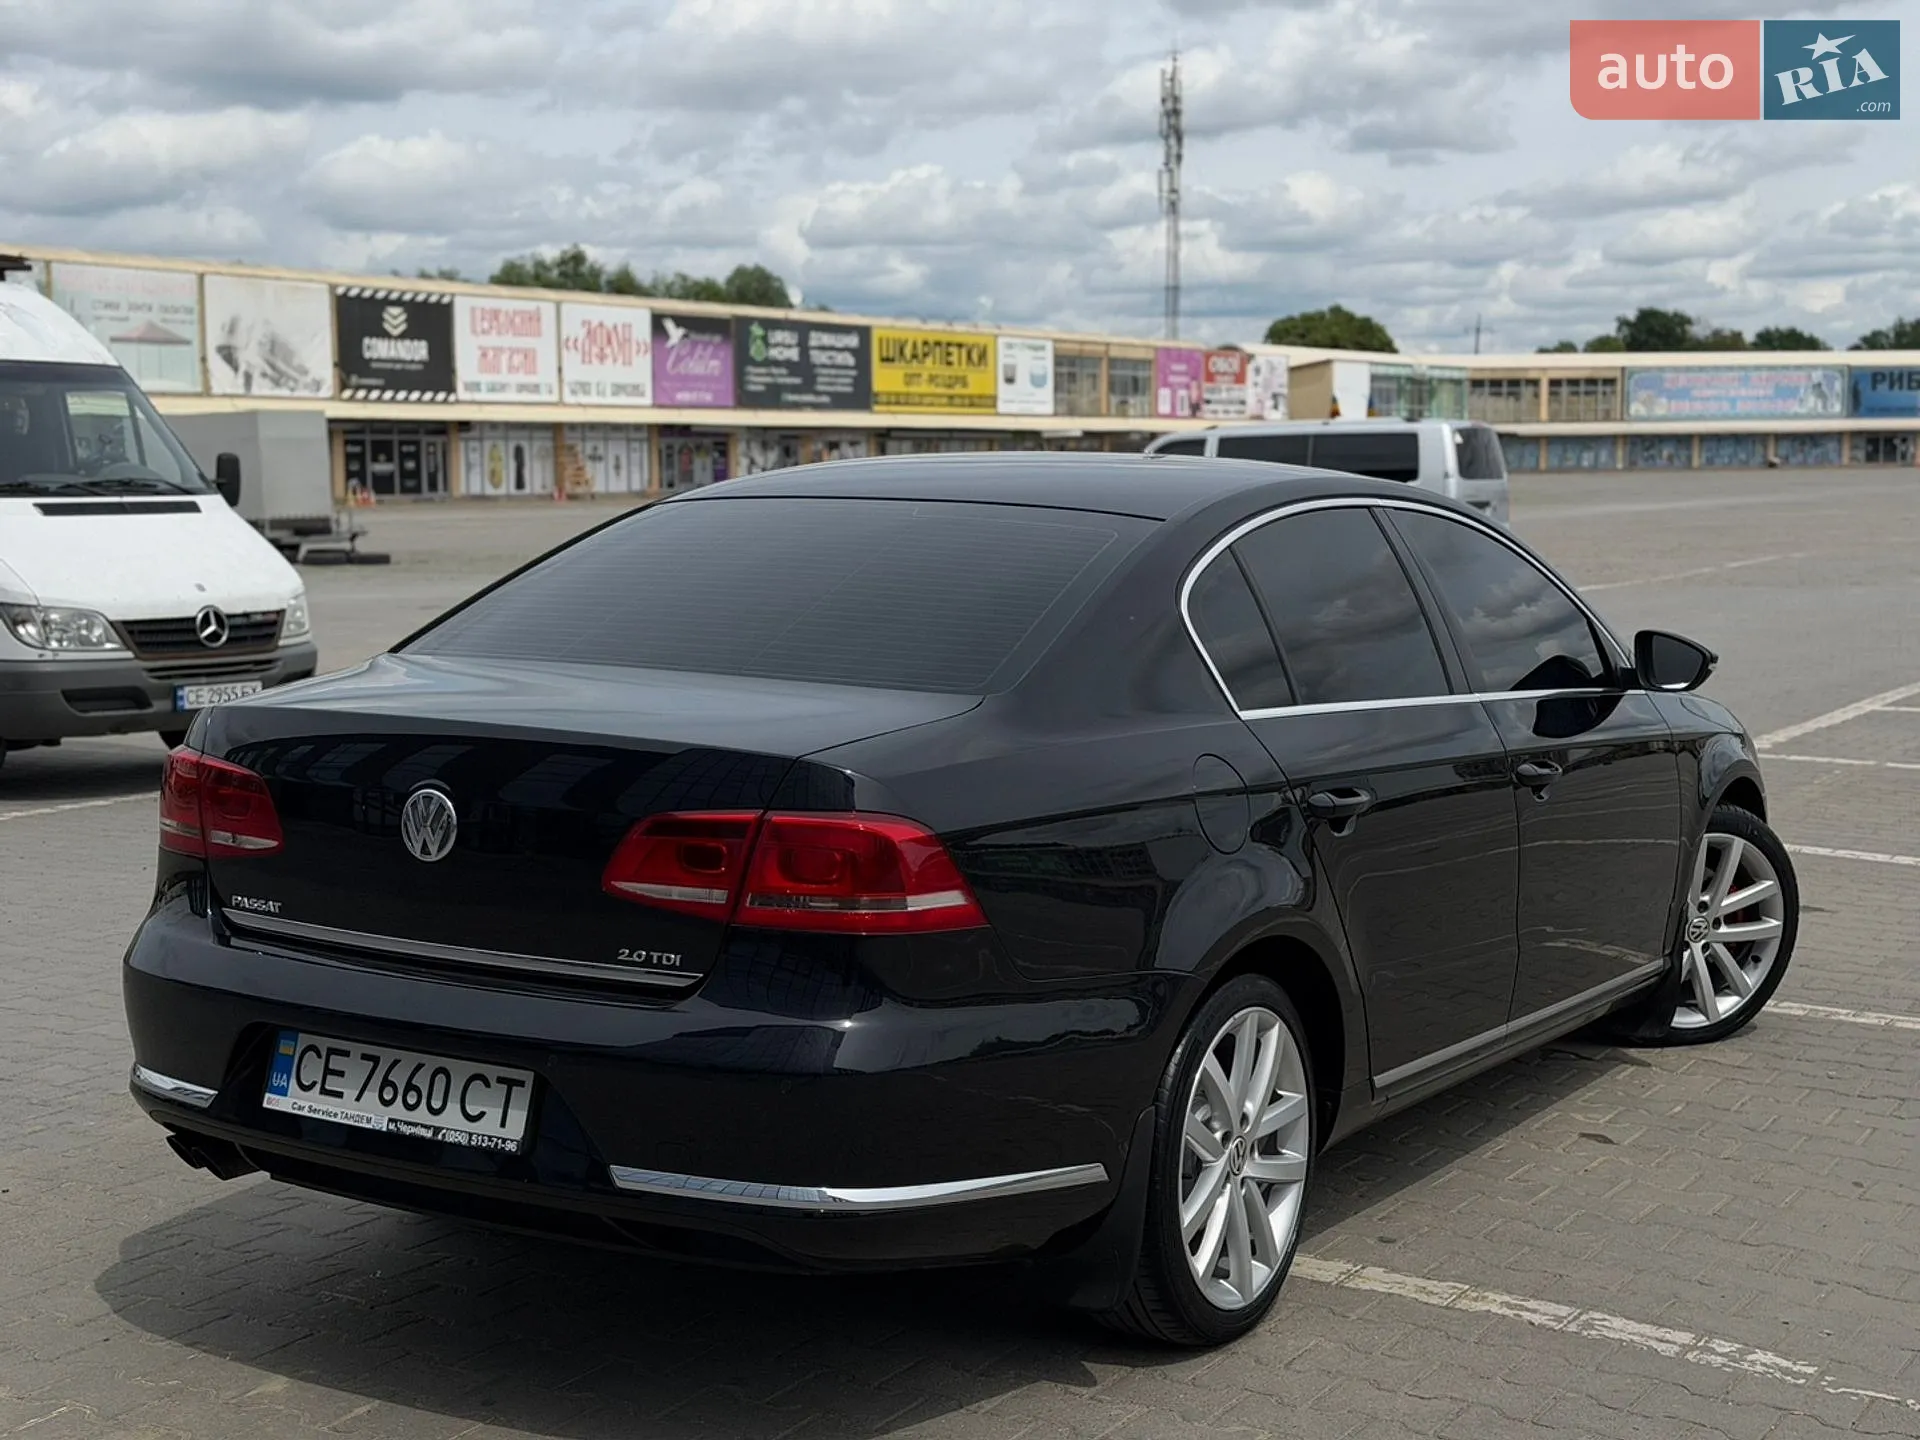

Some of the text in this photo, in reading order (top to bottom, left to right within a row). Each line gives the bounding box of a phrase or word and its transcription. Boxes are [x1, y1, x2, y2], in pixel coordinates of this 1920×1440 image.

[878, 337, 989, 369] ШКАРПЕТКИ
[231, 894, 282, 914] PASSAT
[616, 948, 682, 967] 2.0 TDI
[271, 1071, 288, 1089] UA
[291, 1100, 306, 1112] Car
[307, 1104, 339, 1119] Service
[470, 1133, 518, 1152] 513-71-96
